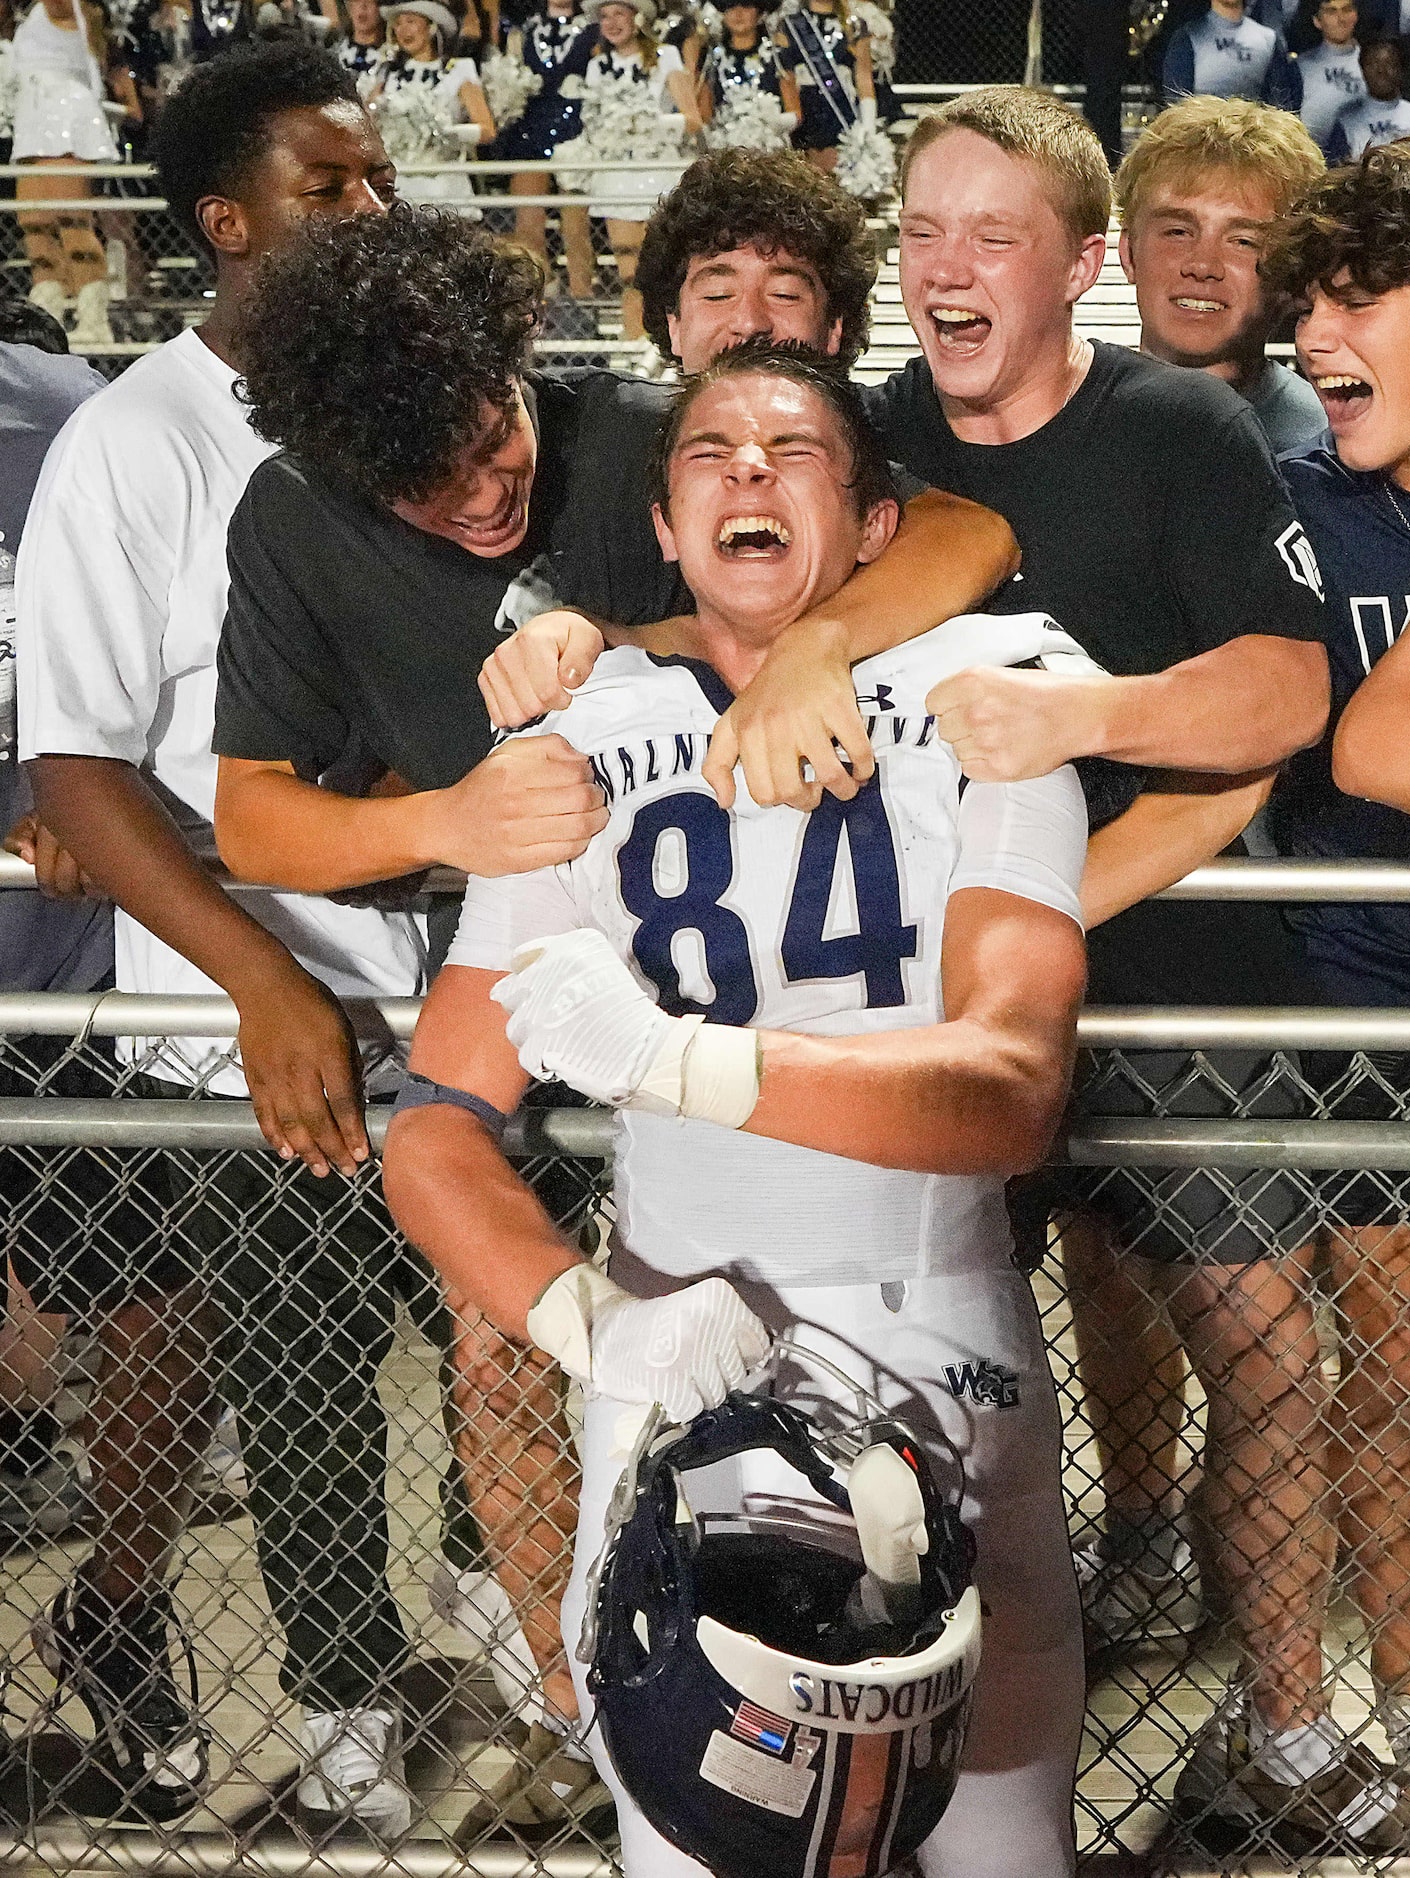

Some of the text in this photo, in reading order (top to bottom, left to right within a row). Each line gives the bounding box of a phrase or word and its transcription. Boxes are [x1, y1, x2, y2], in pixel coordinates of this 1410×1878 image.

[588, 732, 712, 807] WALN
[616, 760, 919, 1028] 84
[789, 1658, 964, 1724] WILDCATS
